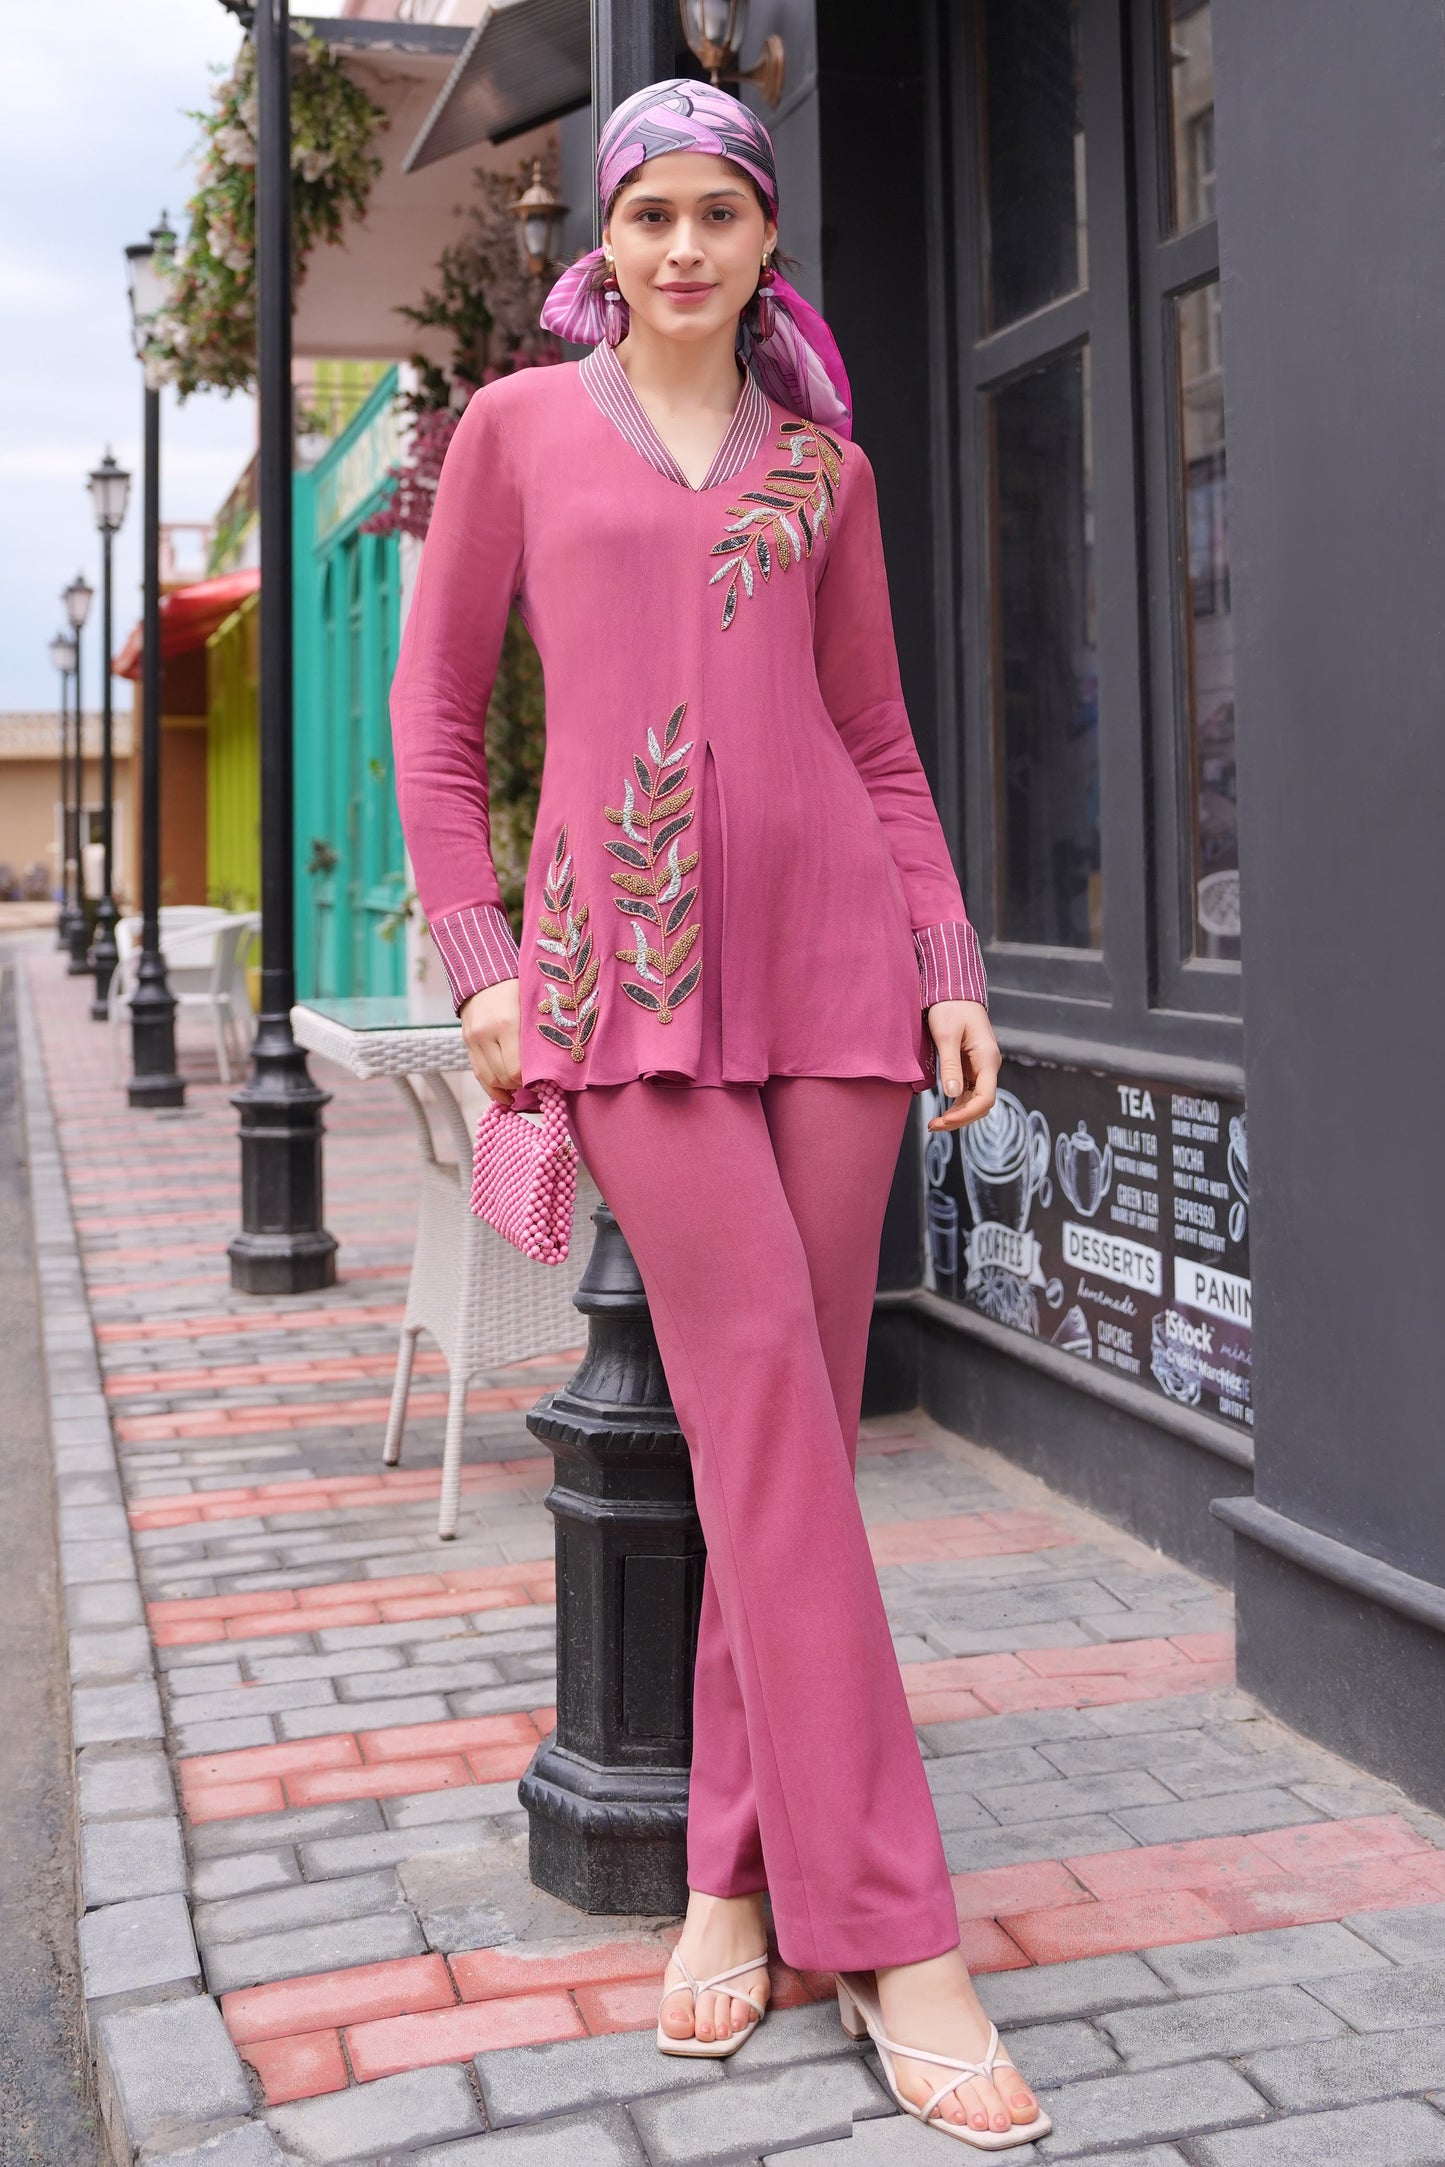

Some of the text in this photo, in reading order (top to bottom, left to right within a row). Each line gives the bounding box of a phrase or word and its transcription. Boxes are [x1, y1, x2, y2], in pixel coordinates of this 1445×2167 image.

[1117, 1084, 1156, 1121] TEA
[1171, 1093, 1220, 1125] AMERICANO
[1106, 1125, 1140, 1152] VANILLA
[1141, 1132, 1158, 1157] TEA
[1172, 1144, 1205, 1173] MOCHA
[1117, 1183, 1142, 1211] GREEN
[1142, 1190, 1159, 1215] TEA
[1173, 1196, 1216, 1230] ESPRESSO
[977, 1227, 1023, 1267] COFFEE
[1069, 1231, 1155, 1285] DESSERTS
[1097, 1320, 1134, 1354] CUPCAKE
